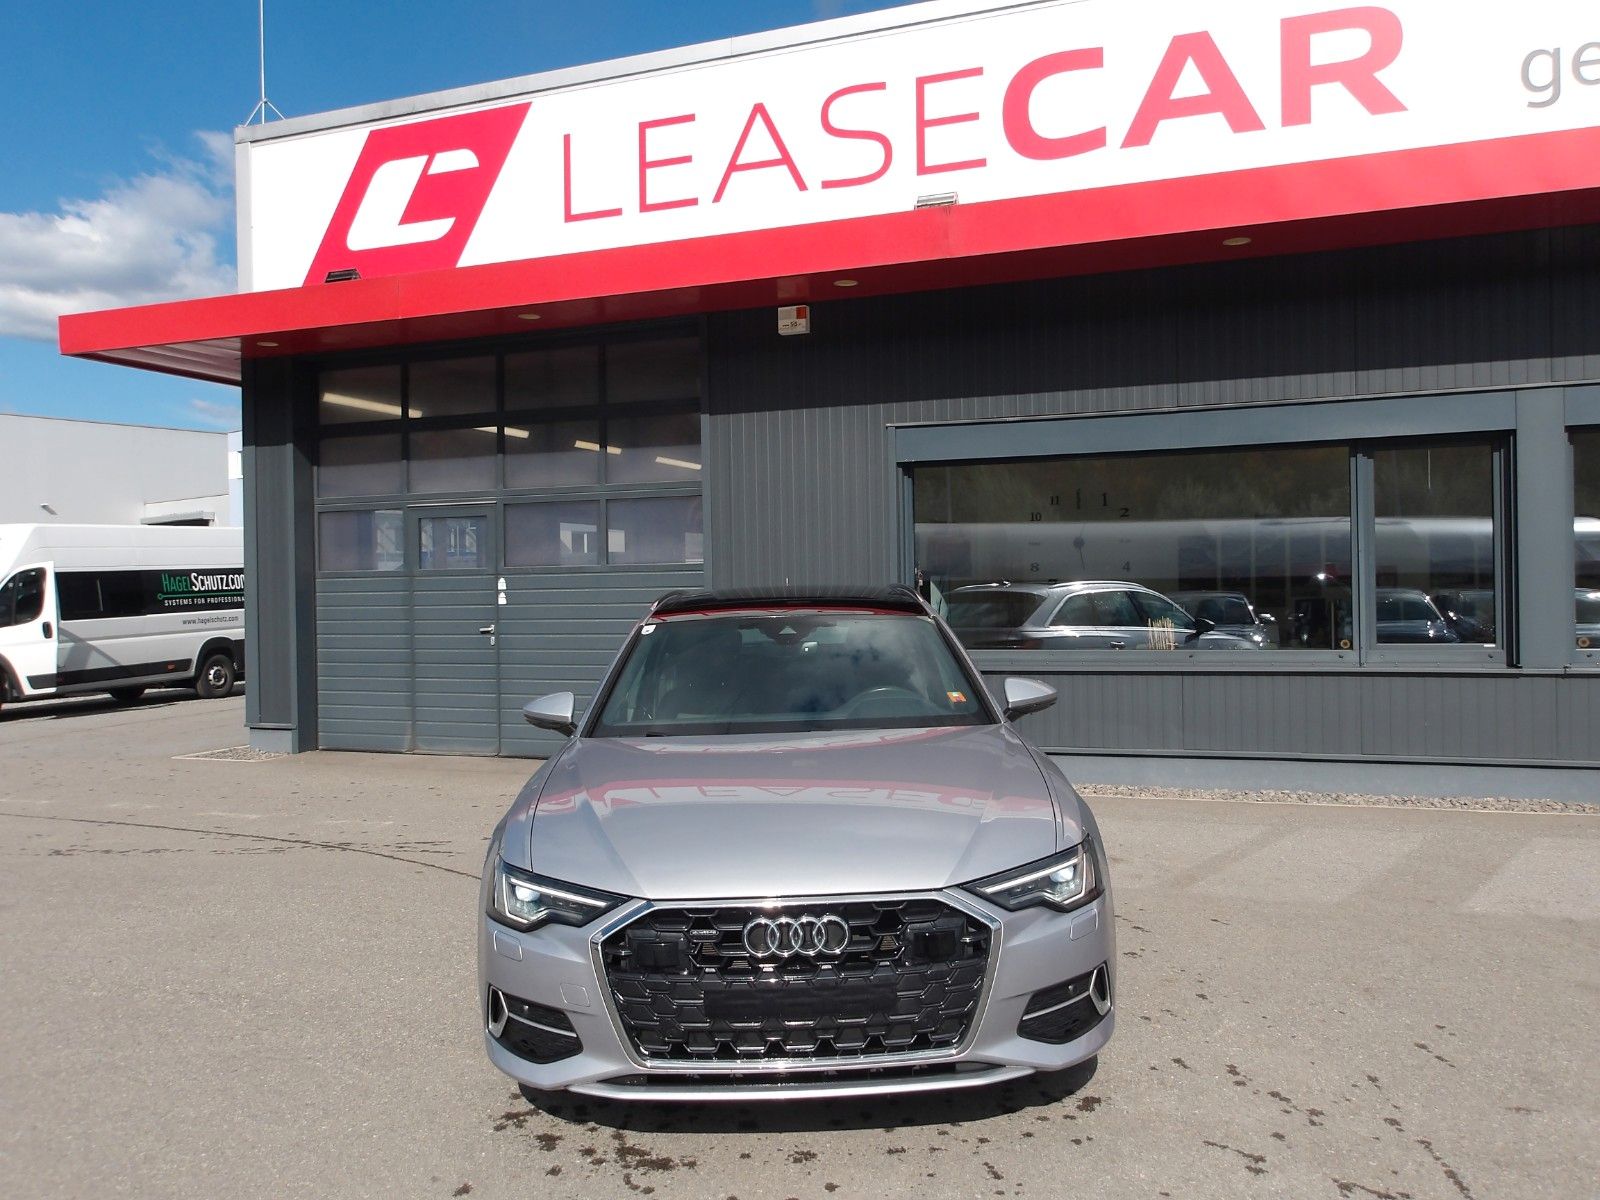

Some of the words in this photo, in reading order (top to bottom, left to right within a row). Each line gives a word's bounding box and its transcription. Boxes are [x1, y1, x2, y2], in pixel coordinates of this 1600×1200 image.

[563, 6, 1409, 223] LEASECAR
[1030, 512, 1042, 522] 10
[194, 597, 206, 605] FOR
